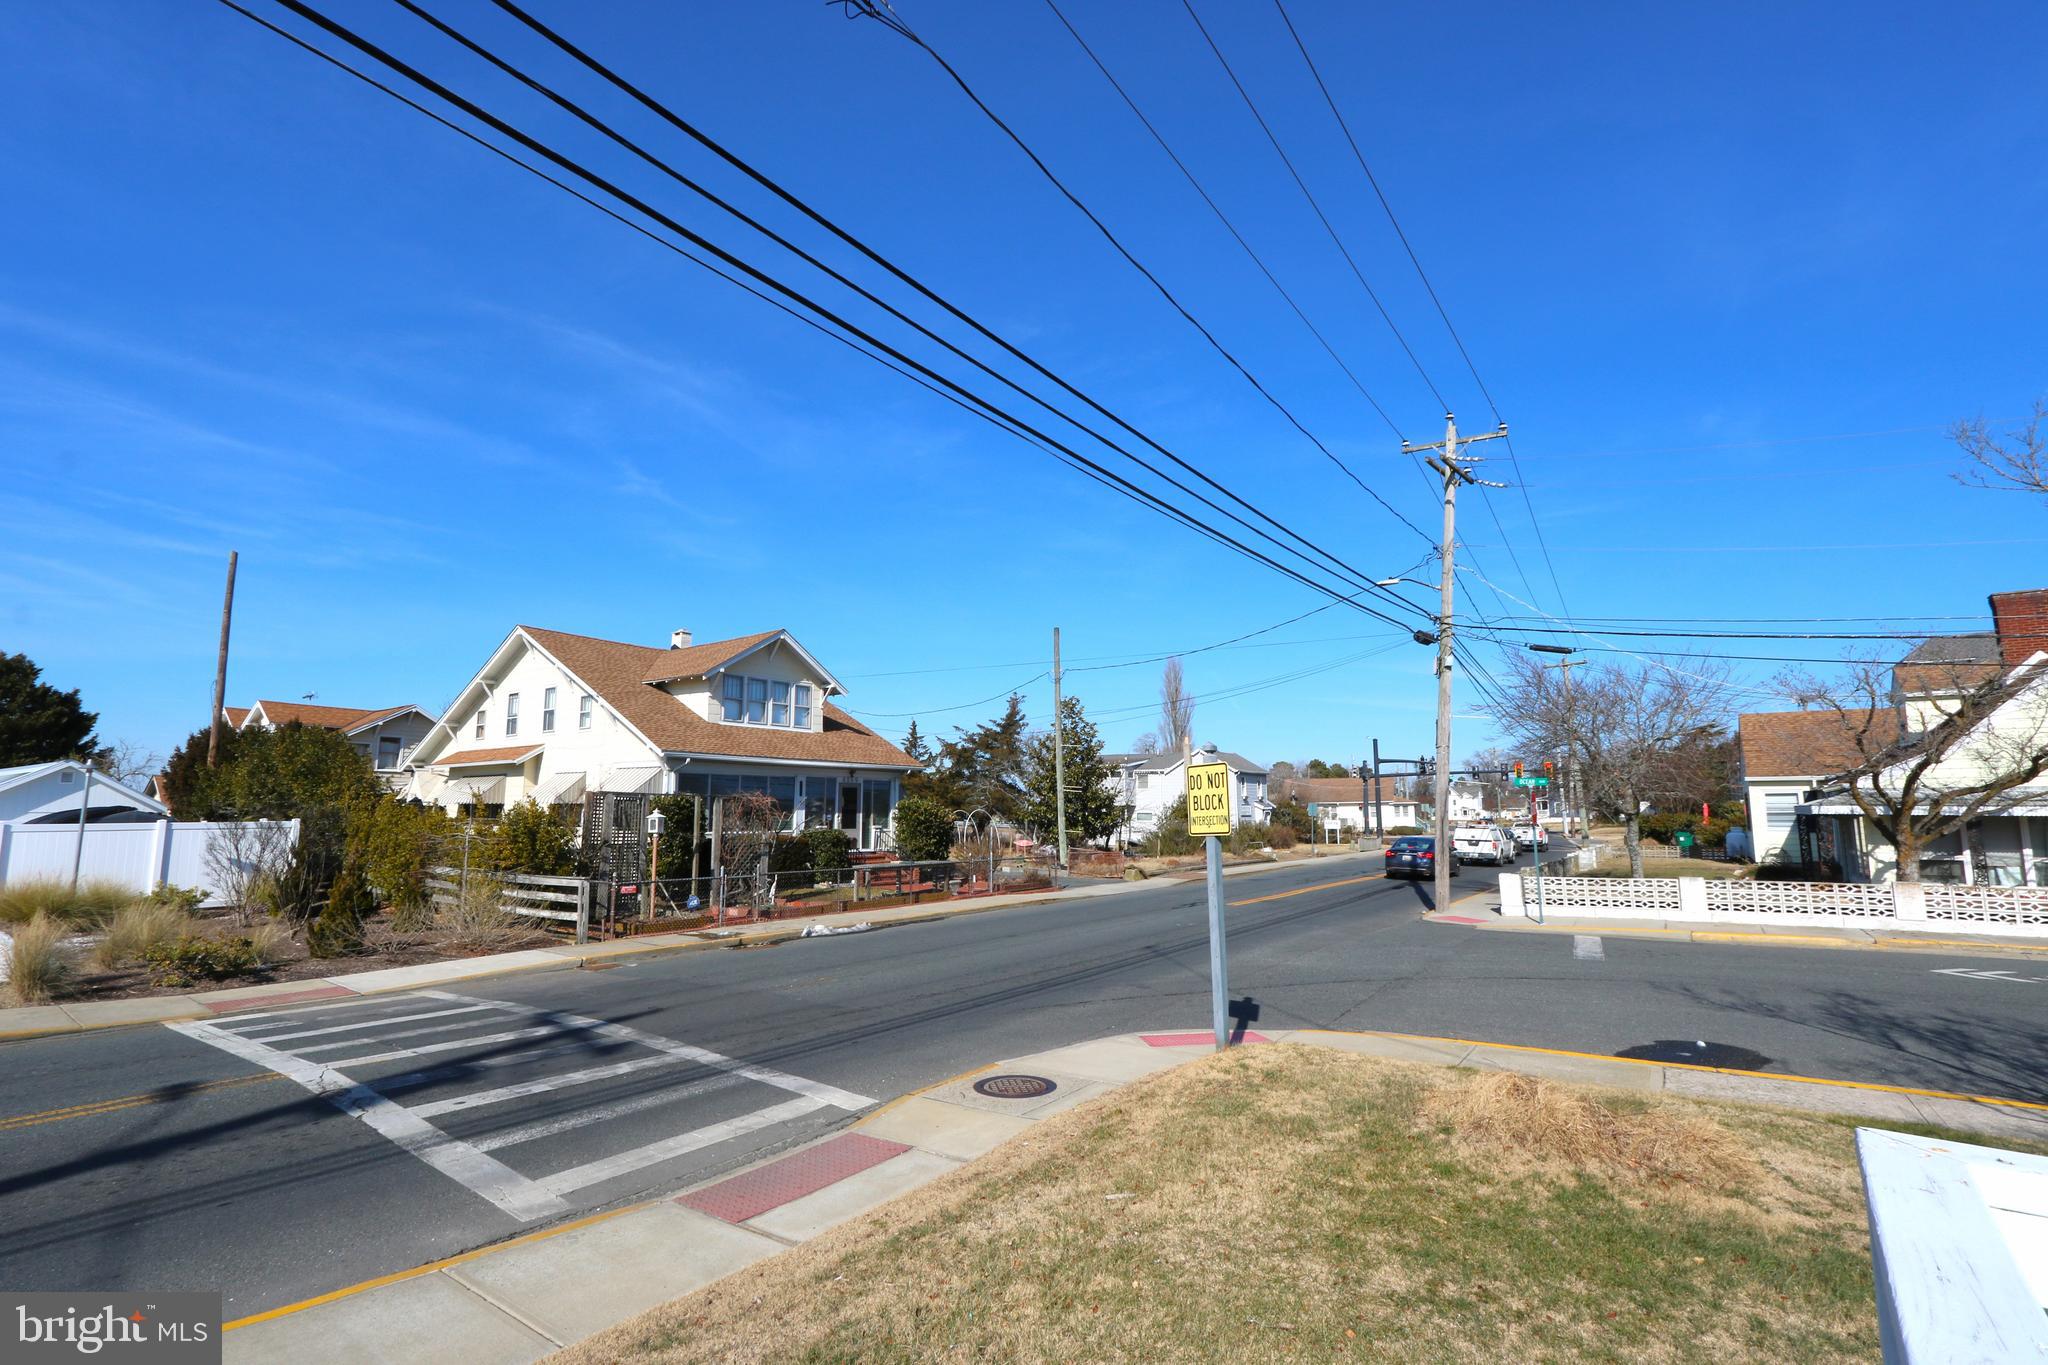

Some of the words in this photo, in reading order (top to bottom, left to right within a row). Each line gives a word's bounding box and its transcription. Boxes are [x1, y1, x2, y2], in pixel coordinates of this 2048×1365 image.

[1190, 774, 1202, 790] DO
[1207, 772, 1225, 789] NOT
[1193, 794, 1225, 811] BLOCK
[1191, 815, 1229, 826] INTERSECTION
